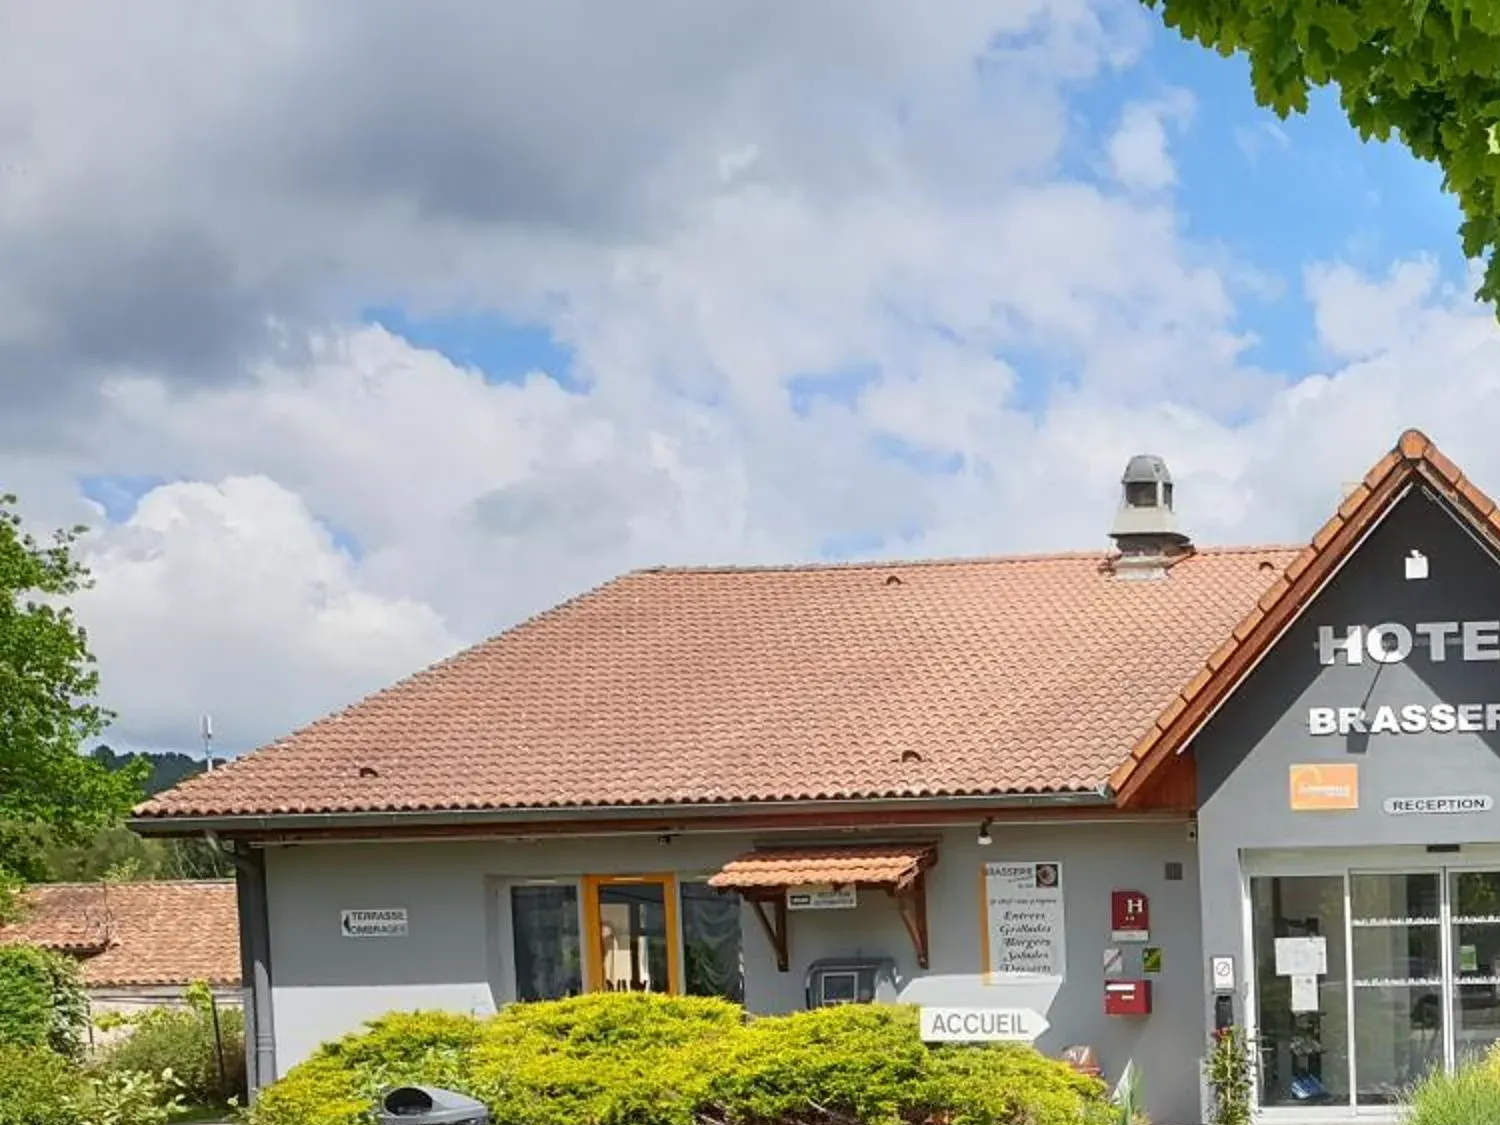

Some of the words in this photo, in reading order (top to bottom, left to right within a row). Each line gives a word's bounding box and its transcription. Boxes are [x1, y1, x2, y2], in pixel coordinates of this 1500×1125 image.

[1393, 799, 1485, 811] RECEPTION
[1127, 899, 1143, 913] H
[351, 911, 404, 921] TERRASSE
[932, 1013, 1029, 1034] ACCUEIL
